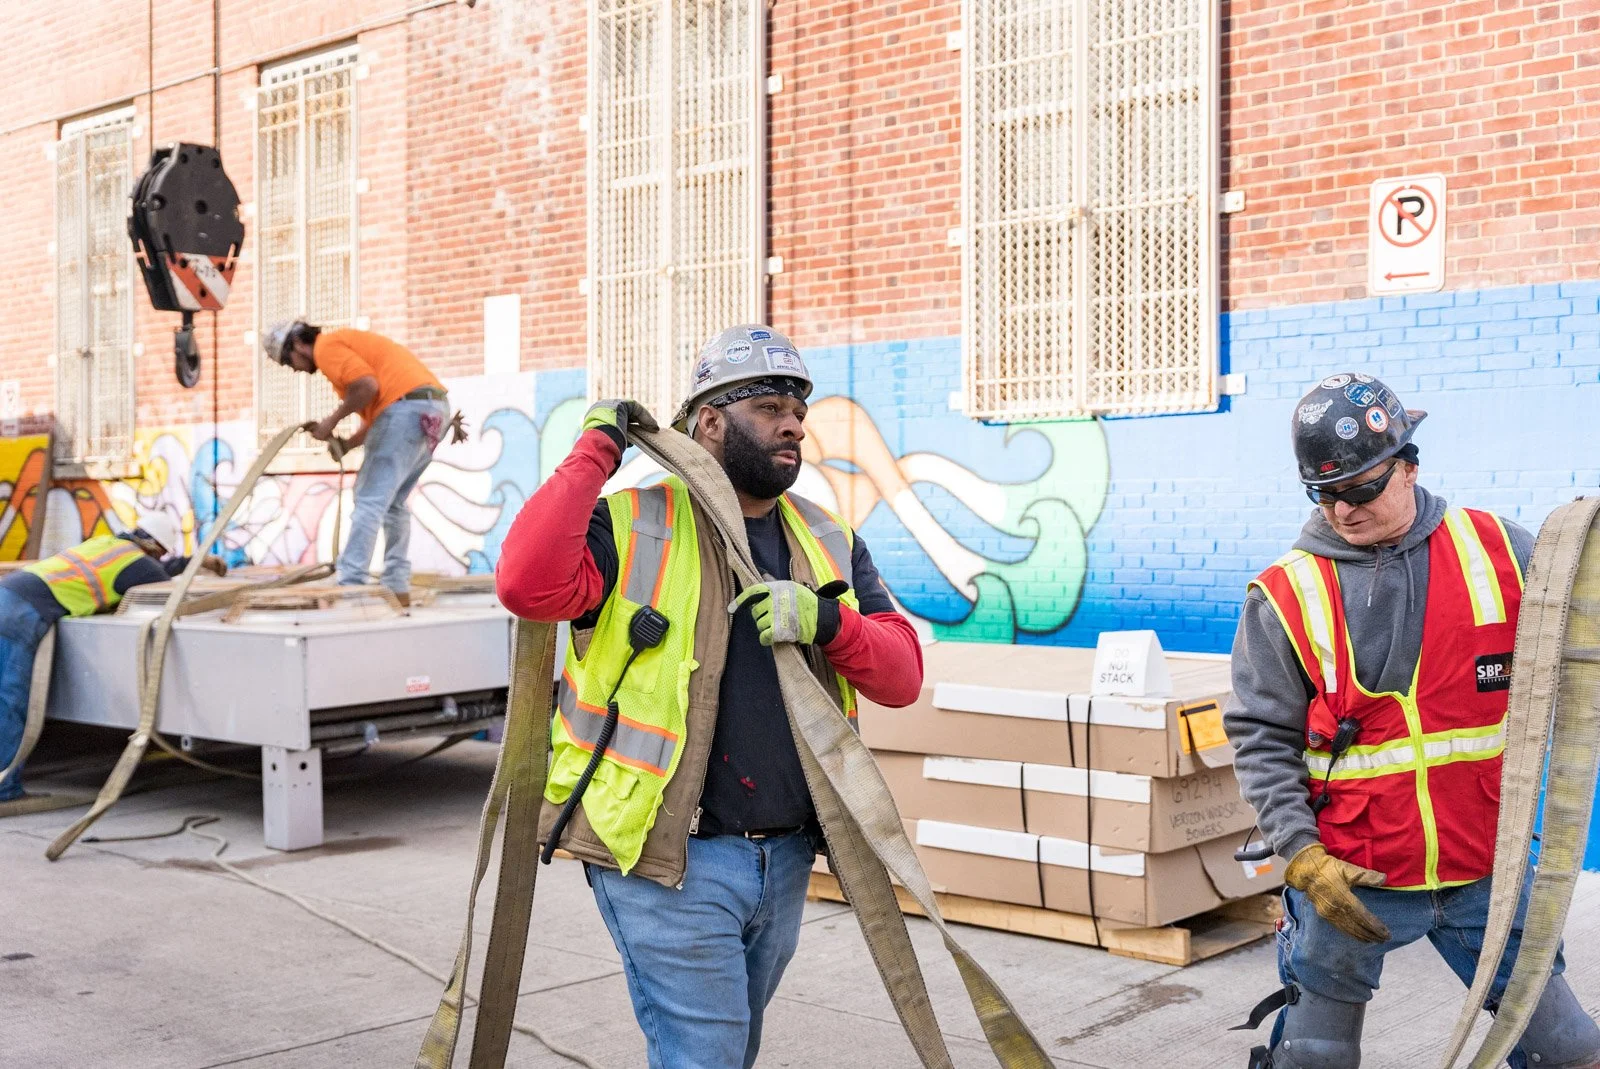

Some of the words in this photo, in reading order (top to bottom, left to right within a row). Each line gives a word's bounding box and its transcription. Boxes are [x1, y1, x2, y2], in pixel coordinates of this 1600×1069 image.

[1397, 196, 1425, 235] P
[1109, 661, 1129, 671] NOT
[1477, 663, 1503, 678] SBP
[1100, 672, 1135, 683] STACK
[1171, 774, 1223, 803] 69294
